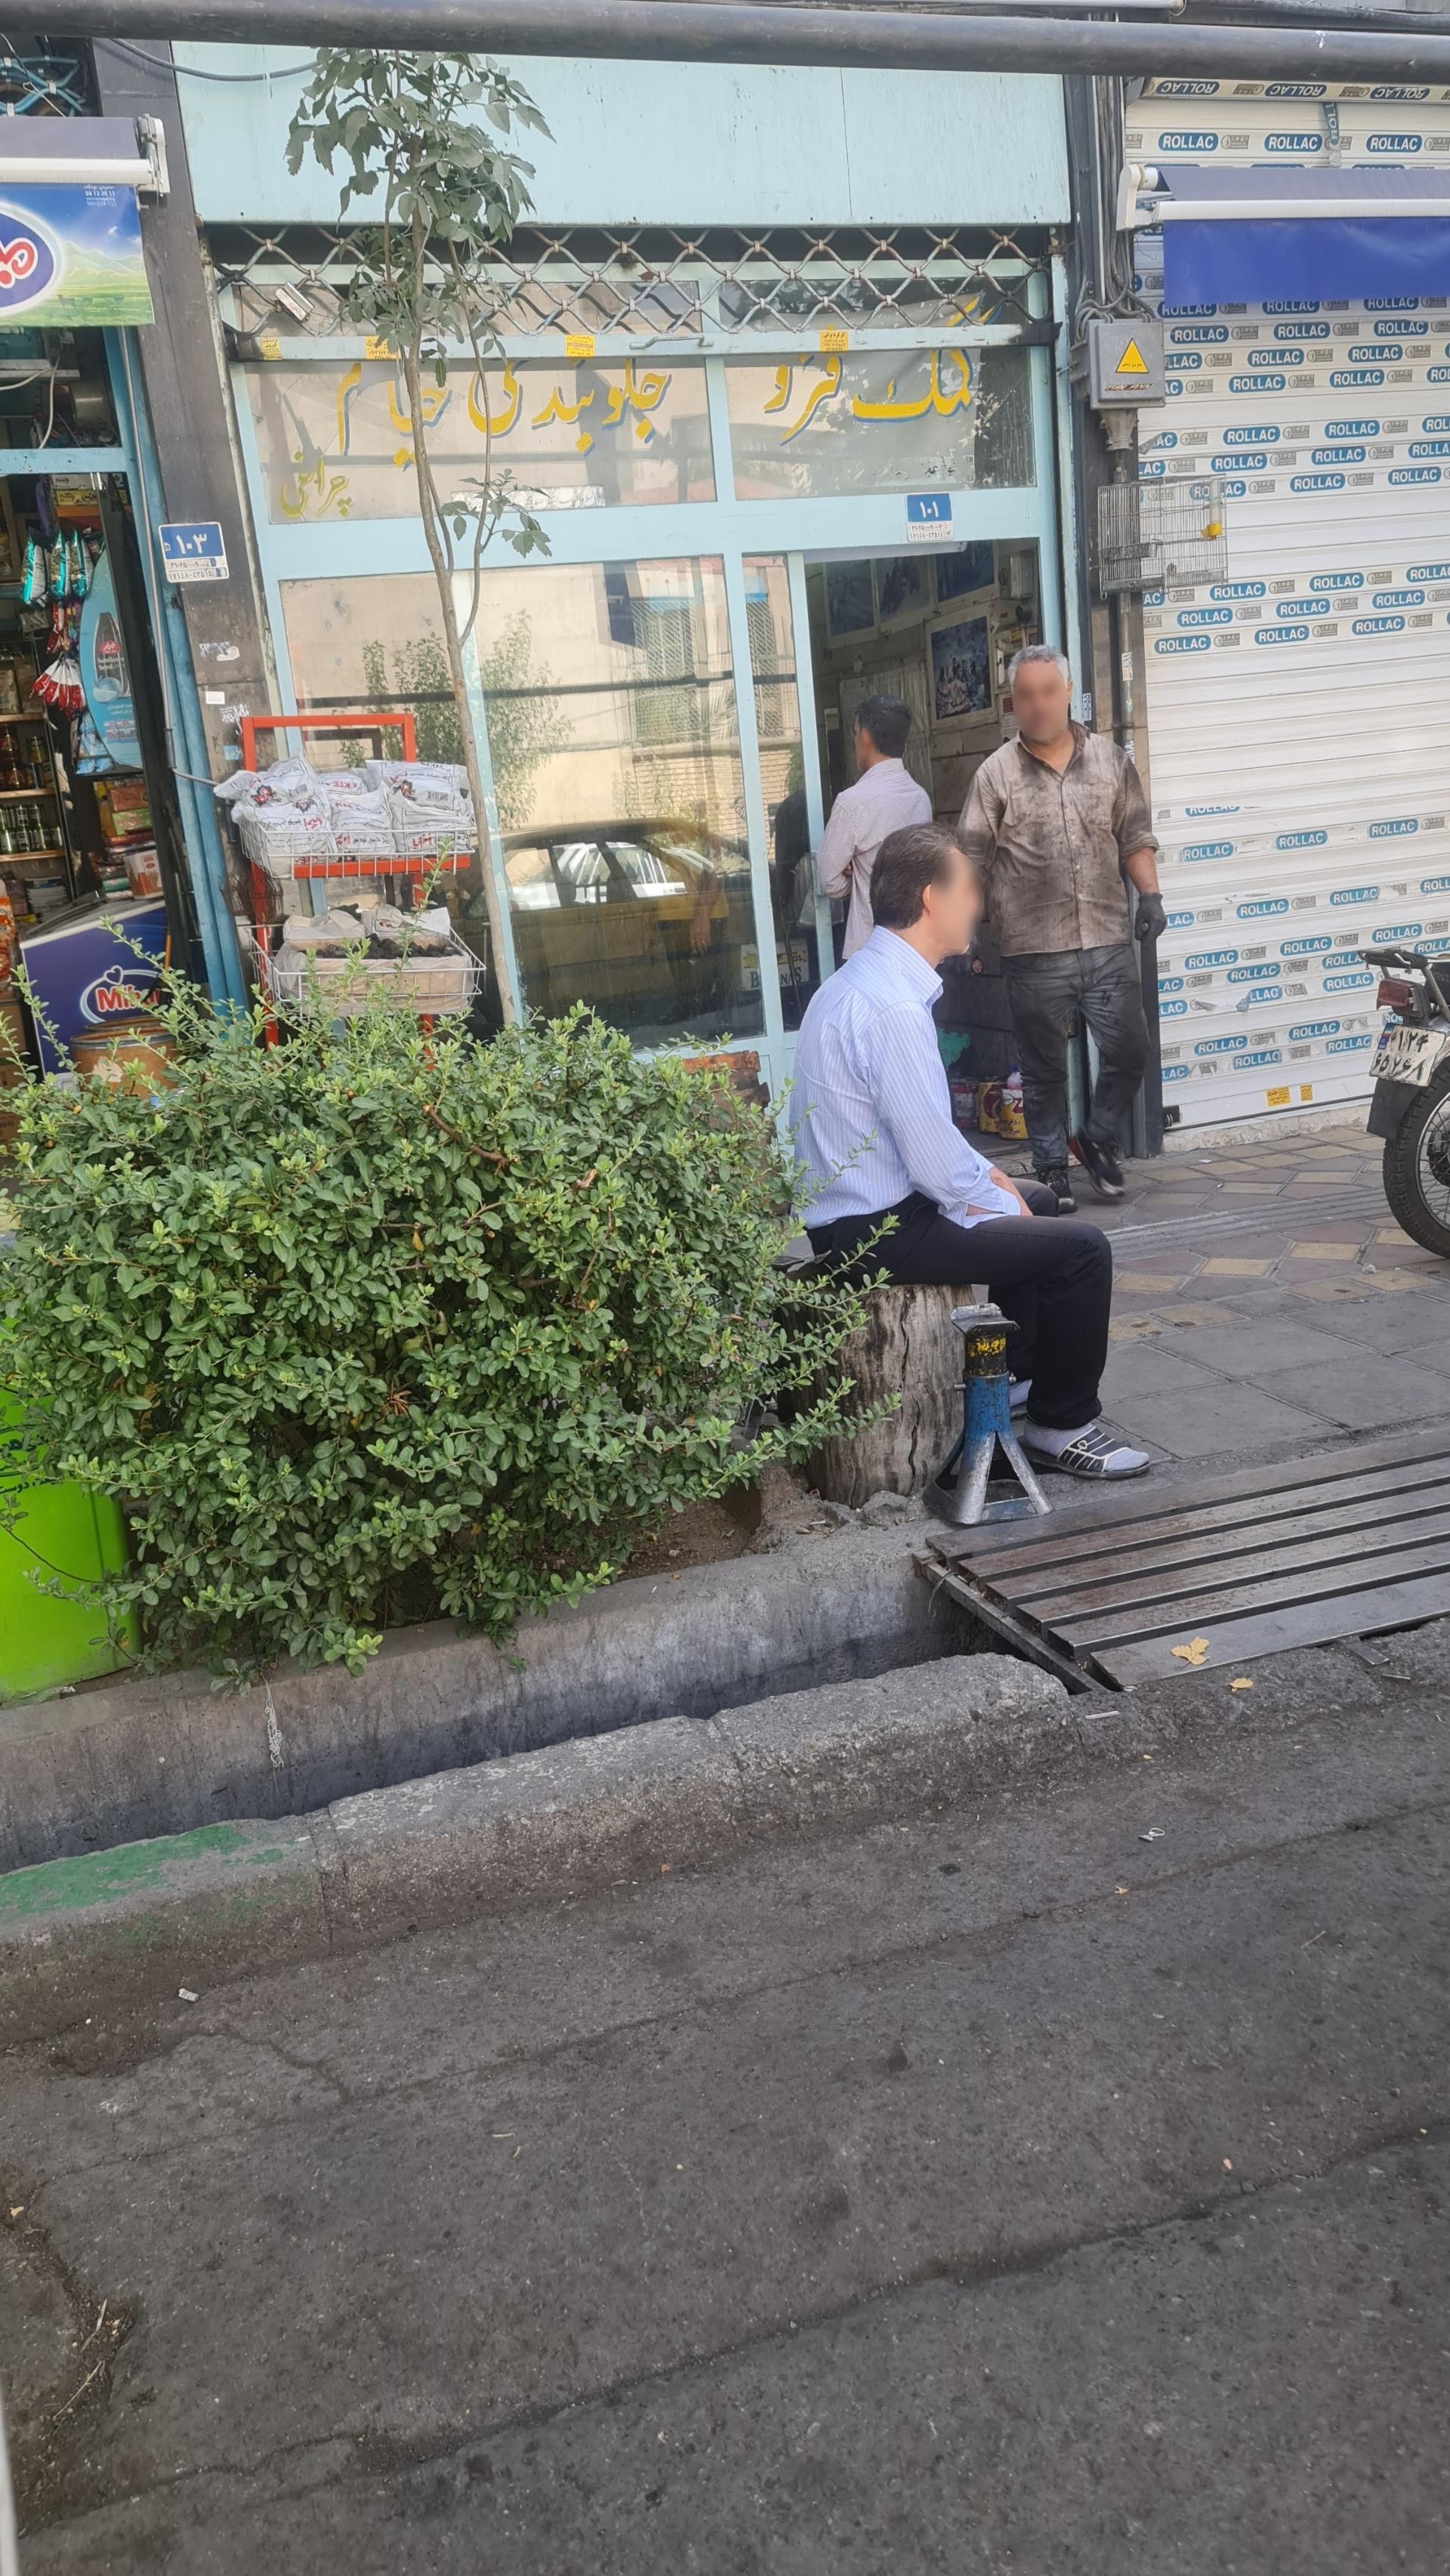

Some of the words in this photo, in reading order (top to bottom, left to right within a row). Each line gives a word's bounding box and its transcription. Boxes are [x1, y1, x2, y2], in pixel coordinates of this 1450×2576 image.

[1161, 82, 1216, 94] ROLLAC
[1270, 85, 1323, 96] ROLLAC
[1325, 101, 1337, 140] ROLL
[1163, 135, 1214, 148] ROLLAC
[1269, 136, 1318, 150] ROLLAC
[1371, 137, 1418, 150] ROLLAC
[1267, 302, 1316, 312] ROLLAC
[1368, 298, 1417, 308] ROLLAC
[1174, 328, 1224, 341] ROLLAC
[1278, 325, 1326, 338] ROLLAC
[1378, 322, 1424, 334] ROLLAC
[1252, 351, 1300, 365] ROLLAC
[1352, 347, 1399, 360] ROLLAC
[1166, 355, 1198, 368] LLAC
[1233, 377, 1282, 391] ROLLAC
[1334, 372, 1381, 386] ROLLAC
[1329, 422, 1375, 436] ROLLAC
[1427, 419, 1450, 430] ROL
[1227, 429, 1276, 443] ROLLAC
[1316, 449, 1362, 462] ROLLAC
[1412, 442, 1450, 456] ROLLA
[1215, 456, 1263, 469] ROLLAC
[1294, 476, 1341, 490] ROLLAC
[1392, 469, 1437, 483] ROLLAC
[1195, 481, 1242, 498] ROAC
[920, 501, 939, 518] ۱۰۱
[176, 533, 207, 554] ۱۰۳
[1313, 575, 1360, 589] ROLLAC
[1214, 584, 1262, 598] ROLLAC
[1376, 592, 1421, 606] ROLLAC
[1280, 601, 1326, 616] ROLLAC
[1181, 610, 1229, 624] ROLLAC
[1356, 618, 1402, 632] ROLLAC
[1259, 628, 1306, 642] ROLLAC
[1158, 638, 1207, 652] ROLLAC
[1371, 821, 1415, 836] ROLLAC
[1279, 832, 1324, 848] ROLLAC
[1184, 845, 1229, 860] ROLLAC
[1424, 878, 1450, 891] ROLL
[1334, 888, 1378, 903] ROLLAC
[1240, 901, 1285, 916] ROLLAC
[1167, 914, 1190, 926] LAC
[1376, 926, 1419, 941] ROLLAC
[1284, 939, 1328, 954] ROLLAC
[1418, 941, 1450, 953] ROLLA
[1189, 953, 1235, 967] ROLLAC
[1326, 955, 1360, 967] ROLLA
[1231, 965, 1277, 980] ROLLAC
[1327, 974, 1371, 990] ROLLAC
[1251, 988, 1279, 1001] LLAC
[1159, 1002, 1183, 1015] LAC
[1293, 1023, 1337, 1038] ROLLAC
[1199, 1038, 1245, 1053] ROLLAC
[1328, 1036, 1370, 1051] ROLLAC
[1236, 1052, 1279, 1067] ROLLAC
[1163, 1067, 1188, 1080] LAC
